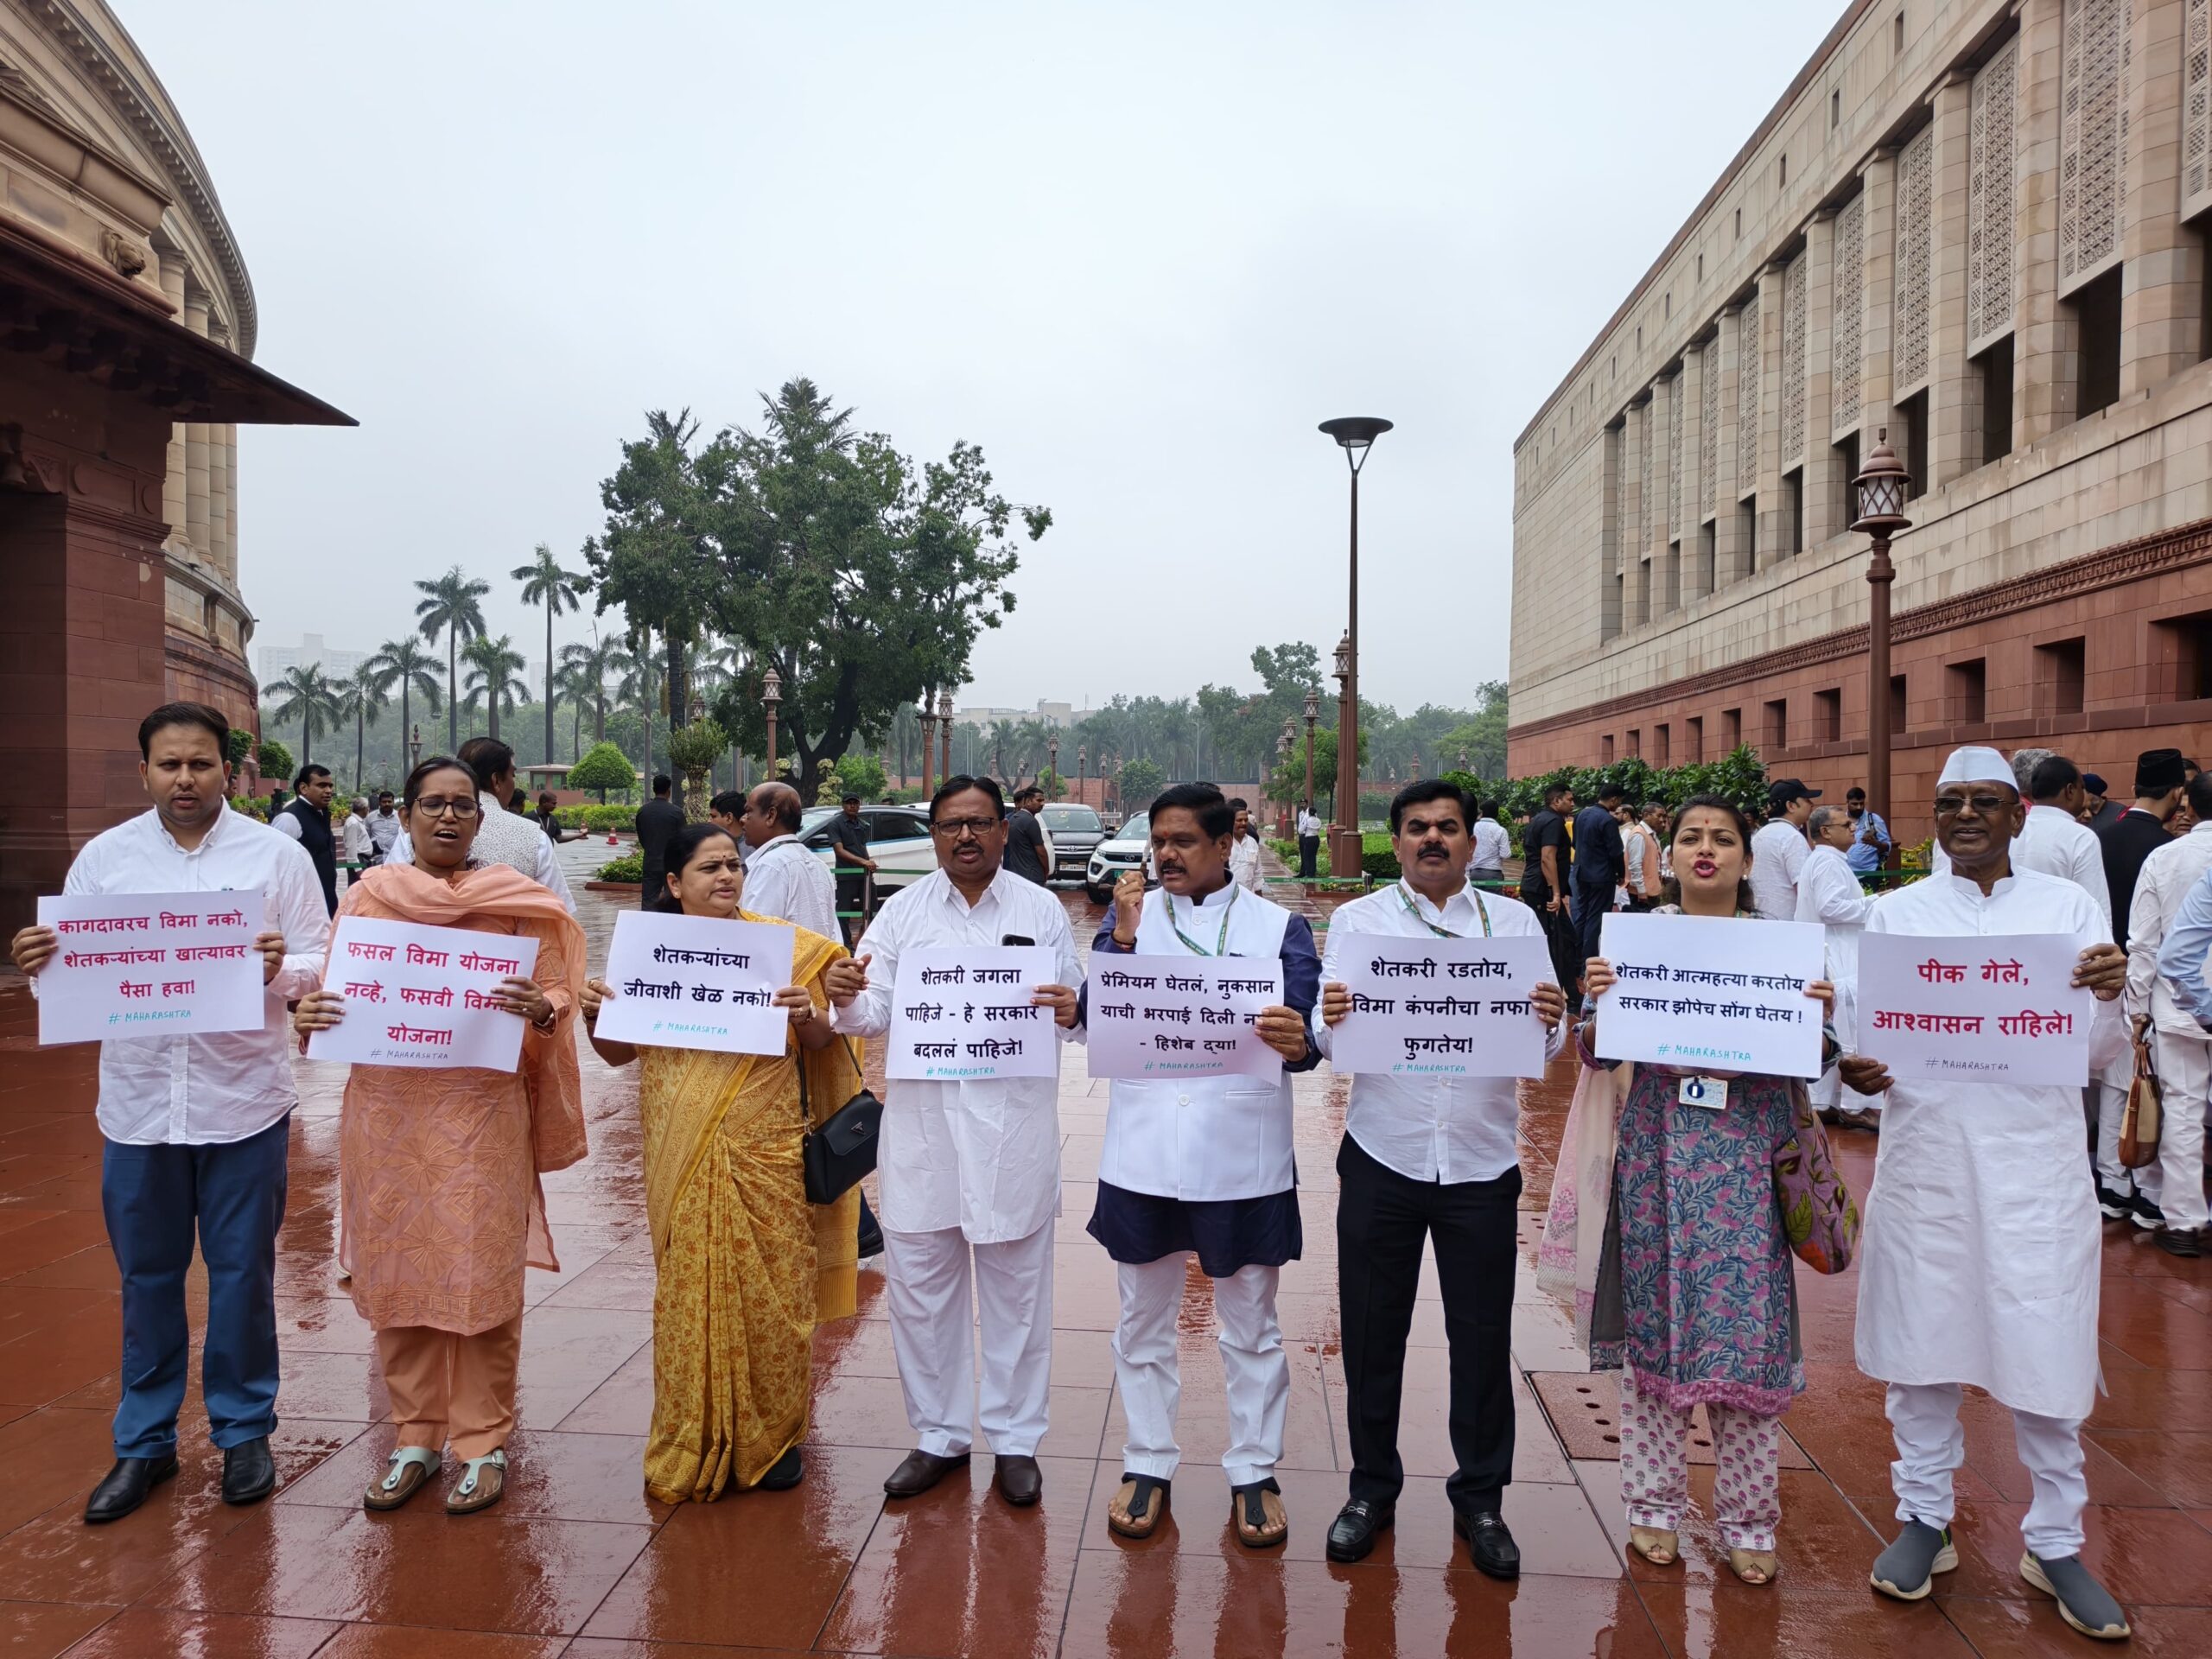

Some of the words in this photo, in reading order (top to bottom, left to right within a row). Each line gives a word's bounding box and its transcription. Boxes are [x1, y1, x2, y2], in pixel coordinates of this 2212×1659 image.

[58, 917, 151, 934] कागदावरच
[158, 911, 199, 929] विमा
[207, 908, 248, 928] नको,
[175, 944, 248, 962] खात्यावर
[347, 942, 397, 962] फसल
[406, 943, 450, 968] विमा
[459, 950, 520, 976] योजना
[921, 964, 966, 985] शेतकरी
[972, 969, 1022, 984] जगला
[1370, 956, 1438, 979] शेतकरी
[1446, 957, 1512, 980] रडतोय,
[1616, 962, 1669, 982] शेतकरी
[1671, 969, 1749, 987] आत्महत्या
[1751, 974, 1806, 992] करतोय
[1916, 957, 1967, 983] पीक
[1980, 957, 2029, 986] गेले,
[119, 979, 153, 998] पैसा
[161, 979, 195, 998] हवा!
[344, 979, 387, 1004] नव्हे,
[400, 986, 454, 1007] फसवी
[623, 977, 683, 1001] जीवाशी
[690, 982, 725, 1003] खेळ
[732, 988, 772, 1007] नको!
[1100, 970, 1158, 990] प्रेमियम
[1165, 974, 1208, 995] घेतलं,
[1217, 979, 1275, 1001] नुकसान
[905, 1001, 944, 1024] पाहिजे
[963, 1001, 976, 1024] हे
[983, 1004, 1039, 1022] सरकार
[1100, 1002, 1136, 1020] याची
[1143, 1006, 1192, 1026] भरपाई
[1199, 1007, 1236, 1026] दिली
[1351, 992, 1395, 1014] विमा
[1405, 995, 1481, 1016] कंपनीचा
[1490, 1000, 1532, 1016] नफा
[1618, 996, 1670, 1013] सरकार
[1672, 997, 1717, 1016] झोपेच
[1719, 1001, 1752, 1019] सोंग
[387, 1022, 453, 1046] योजना!
[1872, 1010, 1985, 1034] आश्वासन
[1997, 1009, 2073, 1039] राहिले!
[913, 1038, 958, 1059] बदललं
[965, 1038, 1023, 1059] पाहिजे!
[1154, 1033, 1196, 1052] हिशेब
[1403, 1033, 1473, 1061] फुगतेय!
